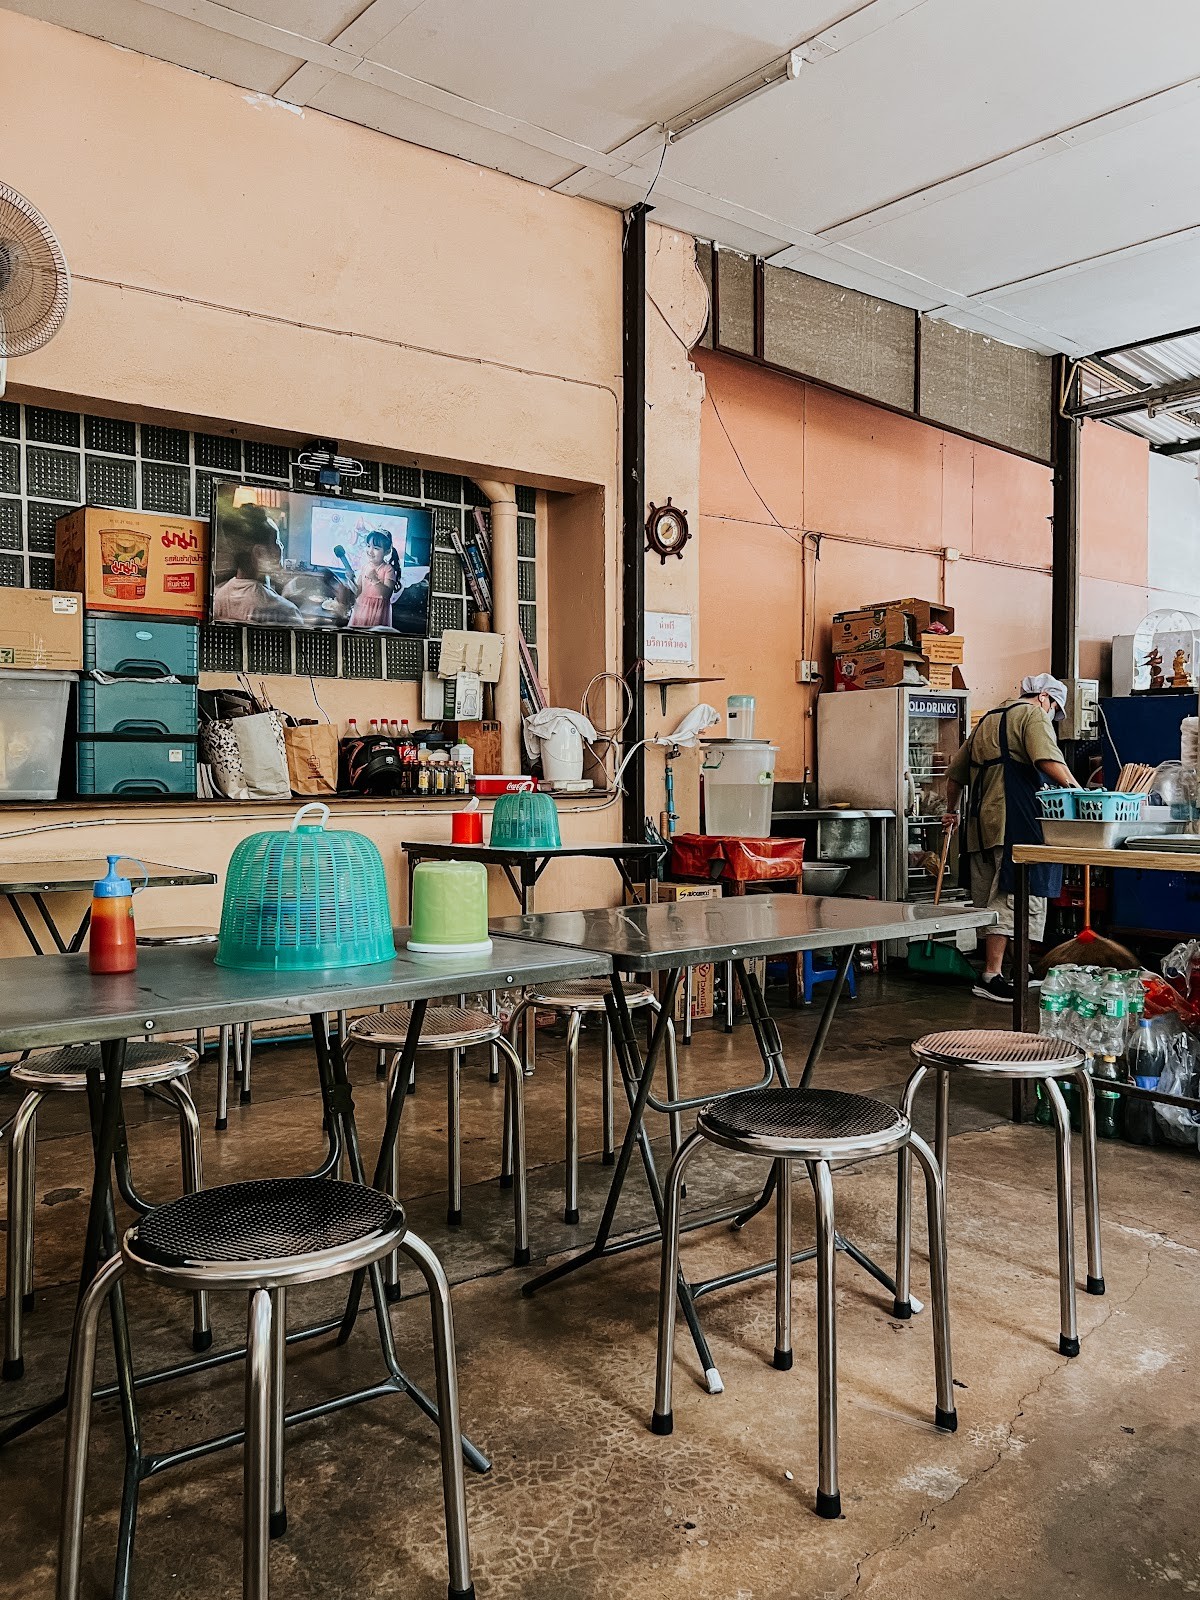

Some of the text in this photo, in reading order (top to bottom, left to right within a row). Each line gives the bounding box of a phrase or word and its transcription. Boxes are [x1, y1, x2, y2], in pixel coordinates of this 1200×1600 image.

[161, 529, 198, 550] มาม่า
[110, 559, 139, 575] มาม่า
[868, 628, 882, 641] 15
[646, 635, 688, 649] บริการตัวเอง
[909, 701, 957, 714] OLD DRINKS
